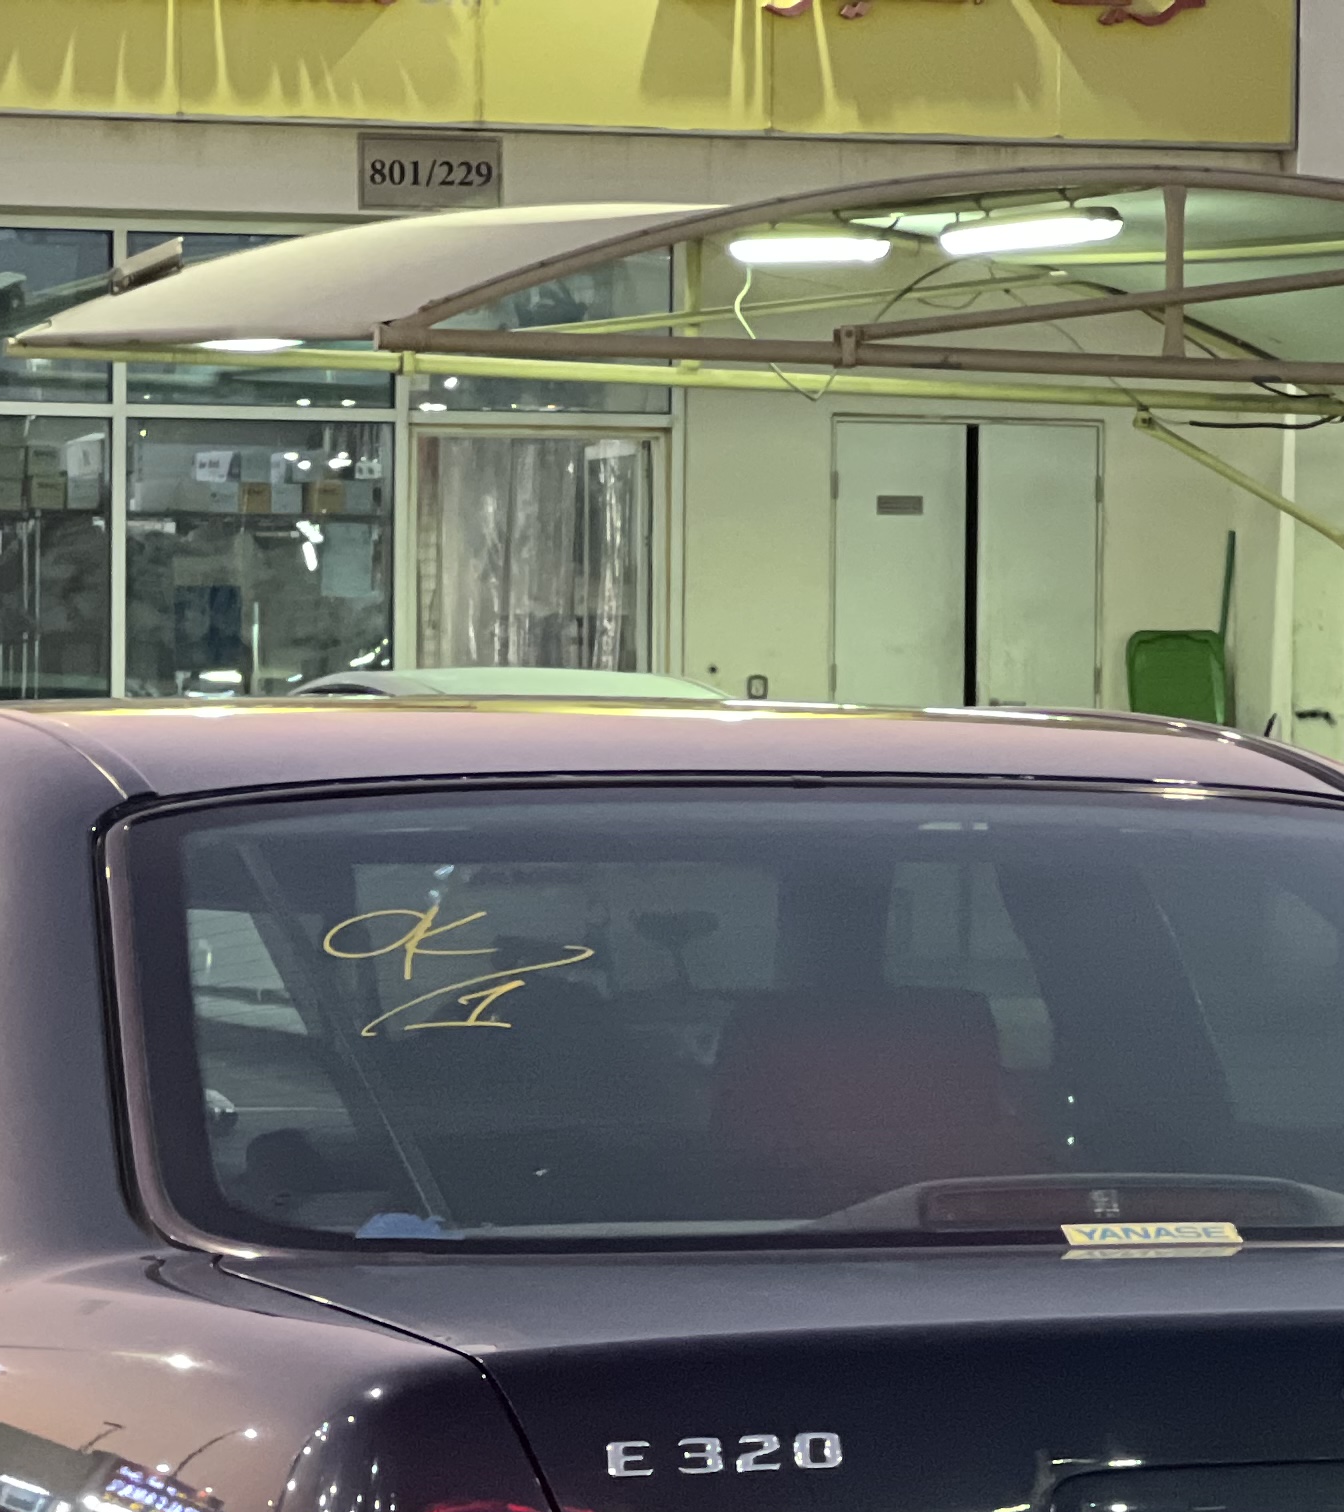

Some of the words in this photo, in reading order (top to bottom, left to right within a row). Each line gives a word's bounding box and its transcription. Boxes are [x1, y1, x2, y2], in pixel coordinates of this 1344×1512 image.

[369, 158, 493, 188] 801/229
[1072, 1226, 1231, 1242] YANASE
[606, 1440, 654, 1477] E
[677, 1431, 843, 1475] 320
